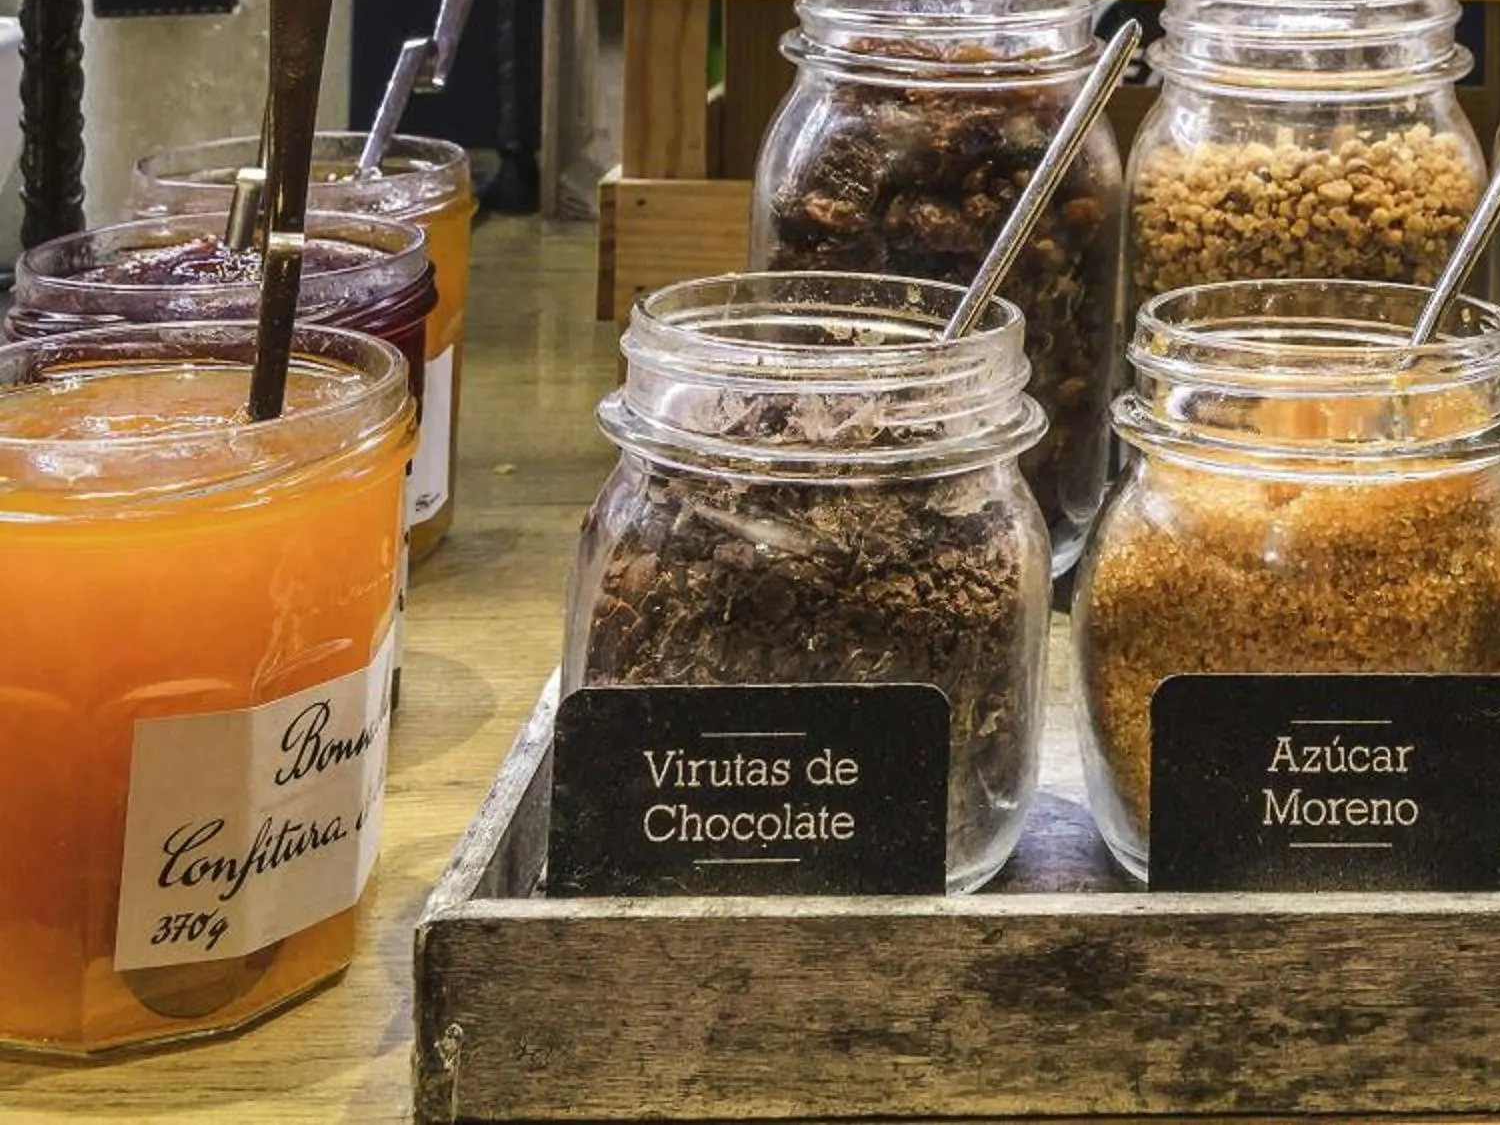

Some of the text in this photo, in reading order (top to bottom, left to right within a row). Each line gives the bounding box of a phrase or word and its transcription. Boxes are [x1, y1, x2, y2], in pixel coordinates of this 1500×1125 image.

[643, 748, 860, 788] Virutas de
[1266, 735, 1415, 774] Azúcar
[642, 803, 856, 843] Chocolate
[1261, 788, 1419, 827] Moreno
[157, 816, 348, 902] Confitura
[150, 908, 229, 952] 370g
